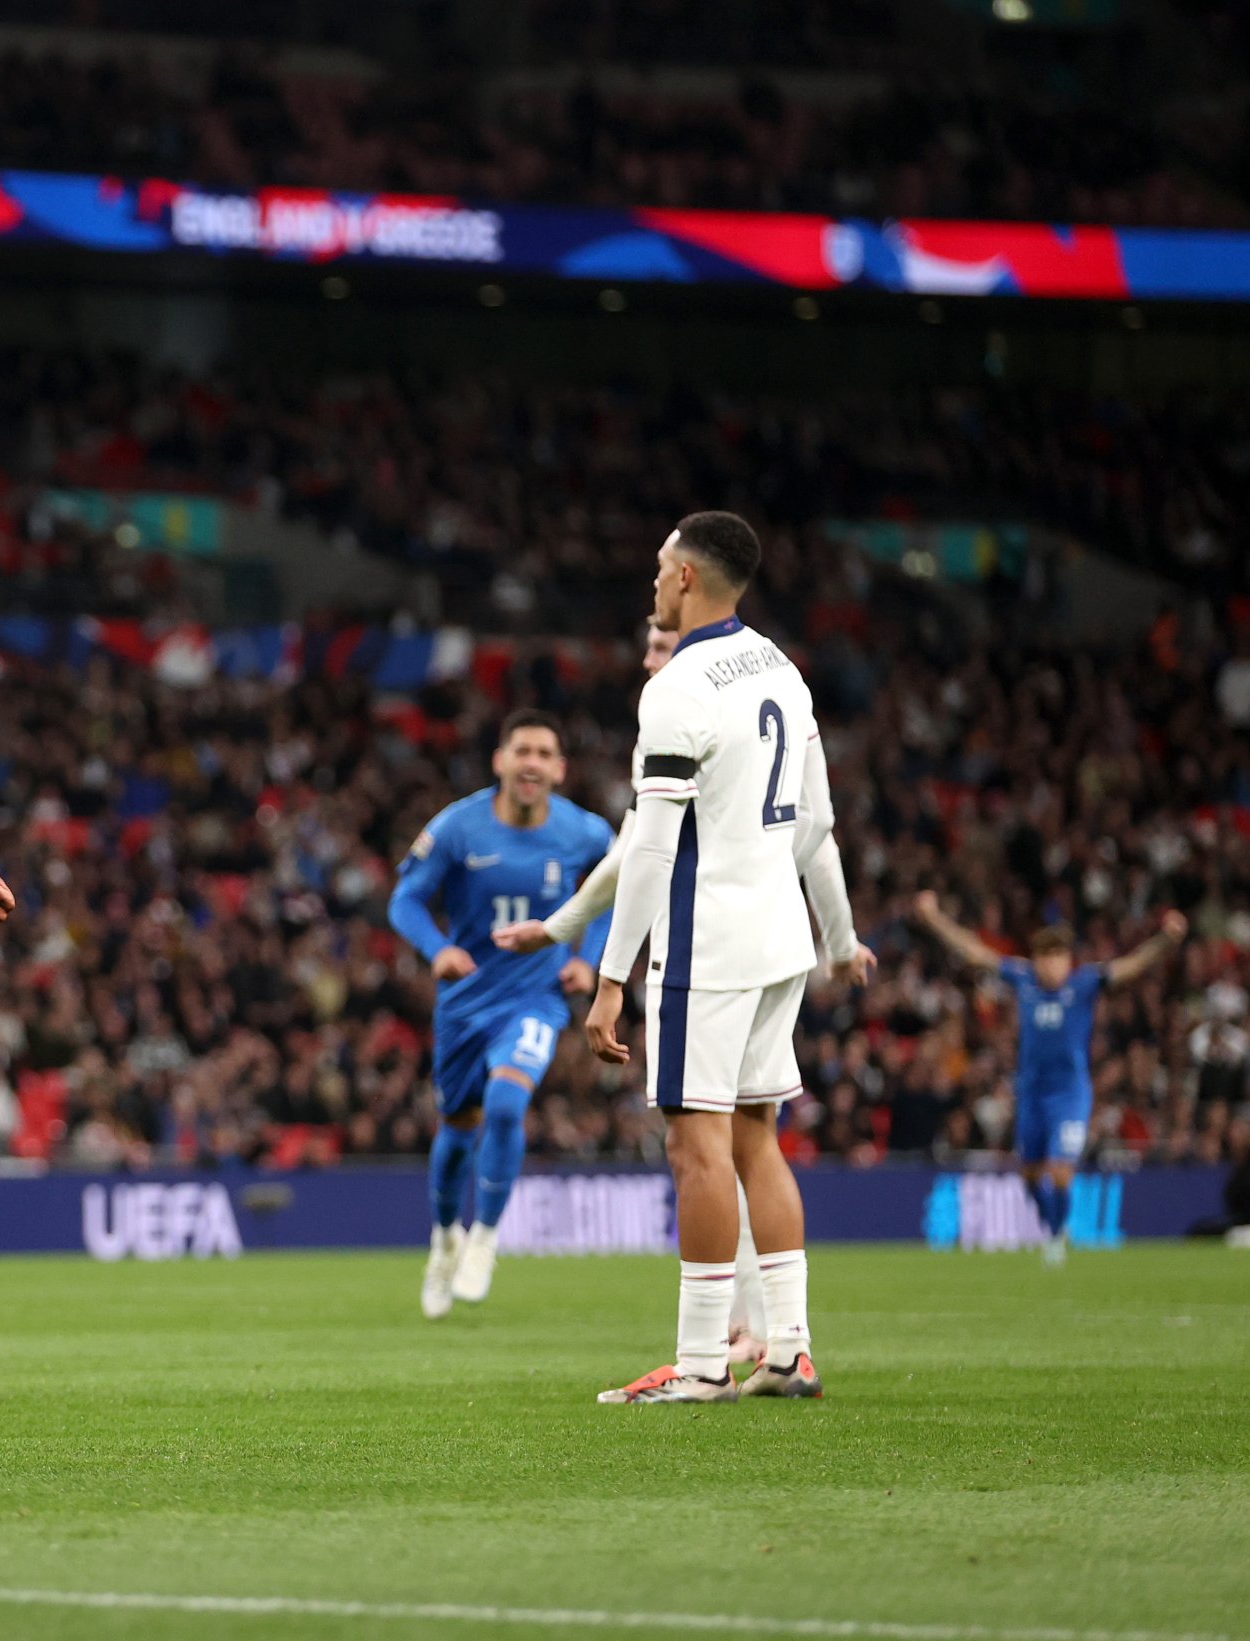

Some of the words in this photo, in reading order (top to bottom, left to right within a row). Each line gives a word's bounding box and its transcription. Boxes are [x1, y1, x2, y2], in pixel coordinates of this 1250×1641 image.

[171, 191, 335, 254] ENGLAND
[369, 204, 504, 262] GREECE
[759, 697, 797, 831] 2
[491, 894, 530, 930] 11
[516, 1016, 555, 1063] 11
[81, 1181, 243, 1261] UEFA
